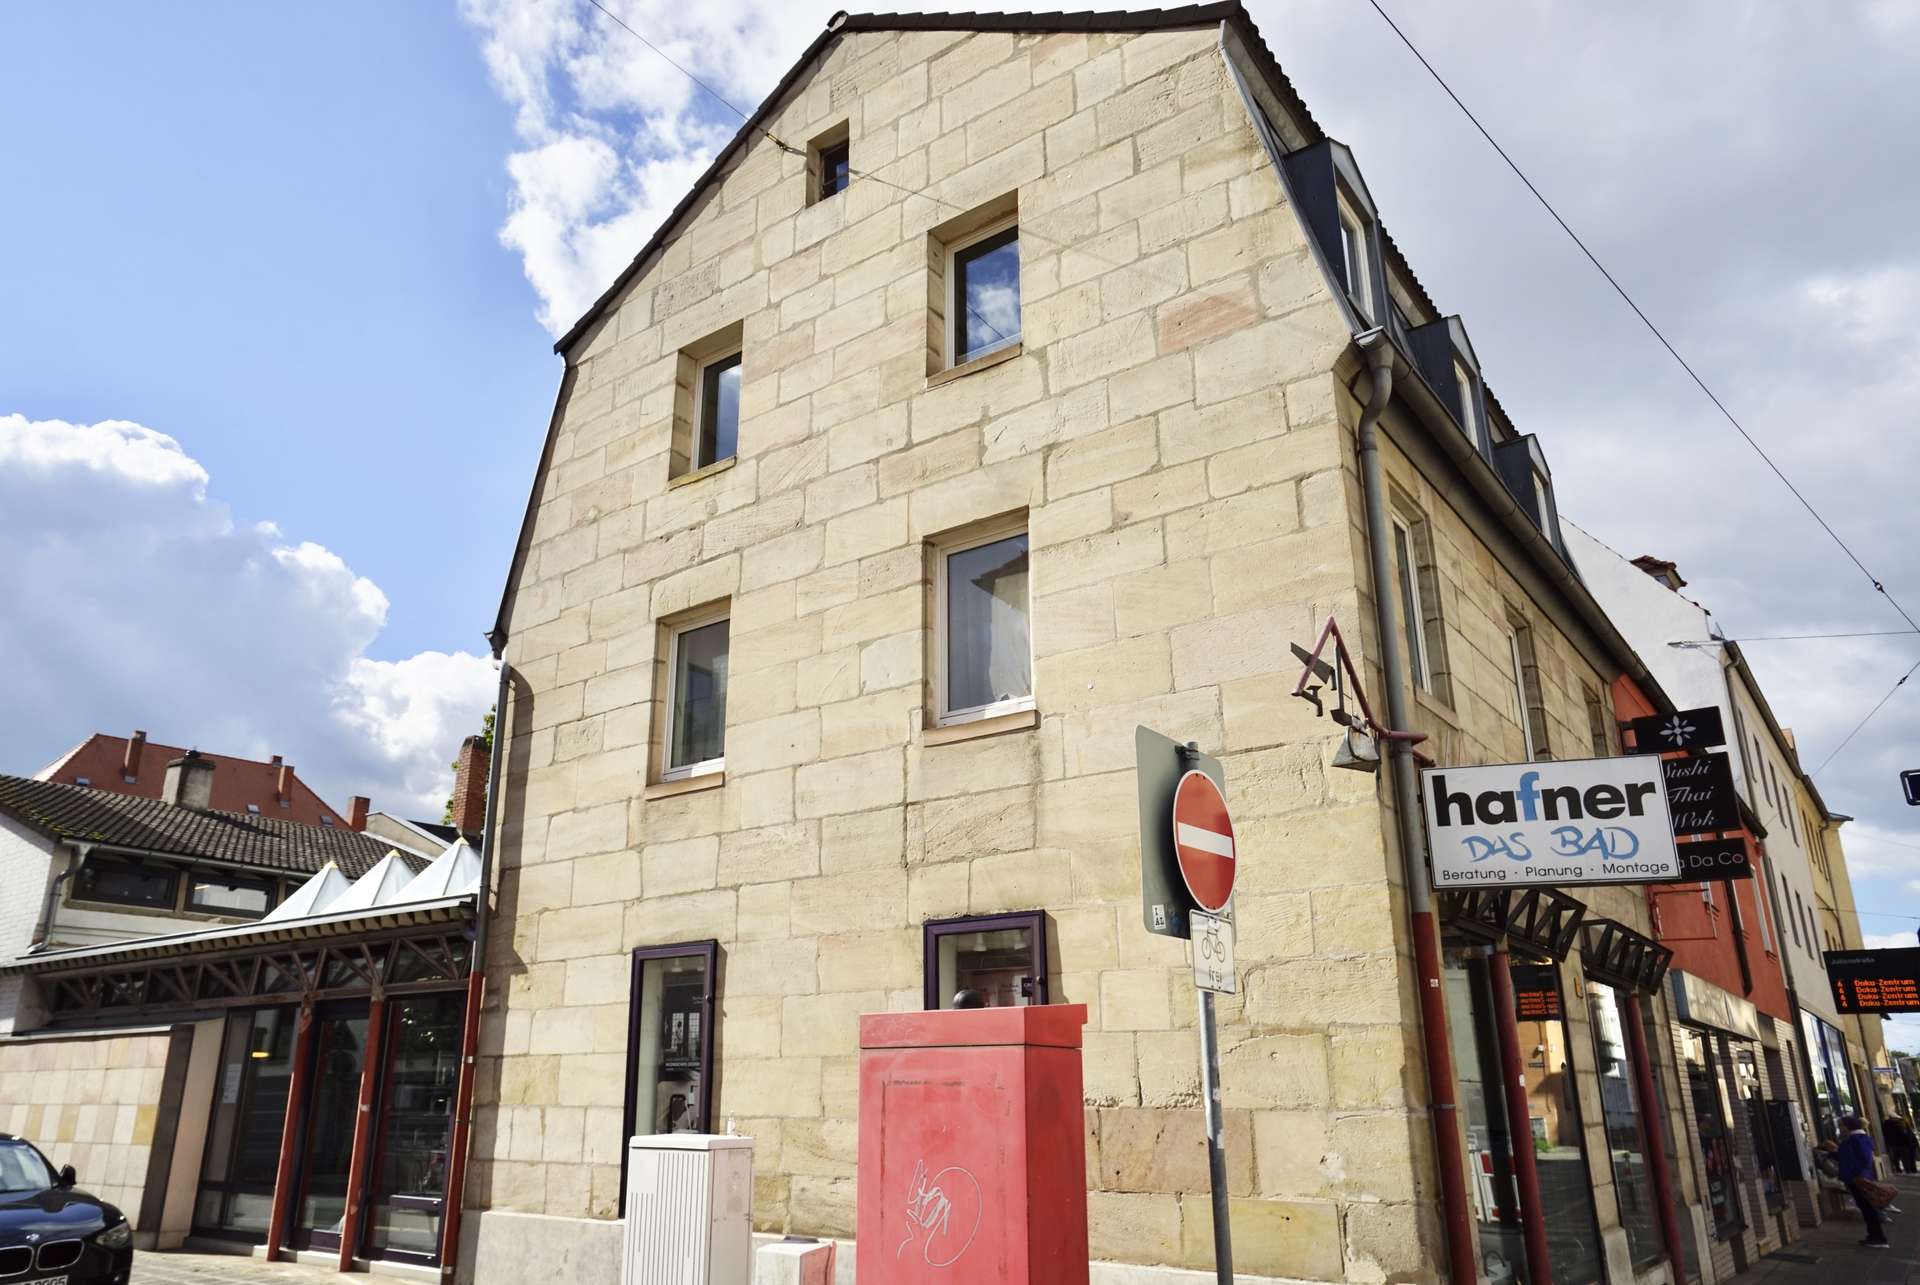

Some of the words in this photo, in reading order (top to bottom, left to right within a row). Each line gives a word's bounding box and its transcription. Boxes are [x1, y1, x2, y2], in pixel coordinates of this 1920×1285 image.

[1666, 760, 1712, 779] Sushi
[1431, 771, 1657, 827] hafner
[1668, 786, 1715, 804] Thai
[1674, 810, 1714, 829] Wok
[1461, 831, 1533, 863] DAS
[1550, 825, 1640, 861] BAD
[1689, 855, 1714, 868] Da
[1718, 852, 1744, 865] Co
[1442, 868, 1507, 881] Beratung
[1525, 865, 1583, 878] Planung
[1602, 862, 1670, 875] Montage
